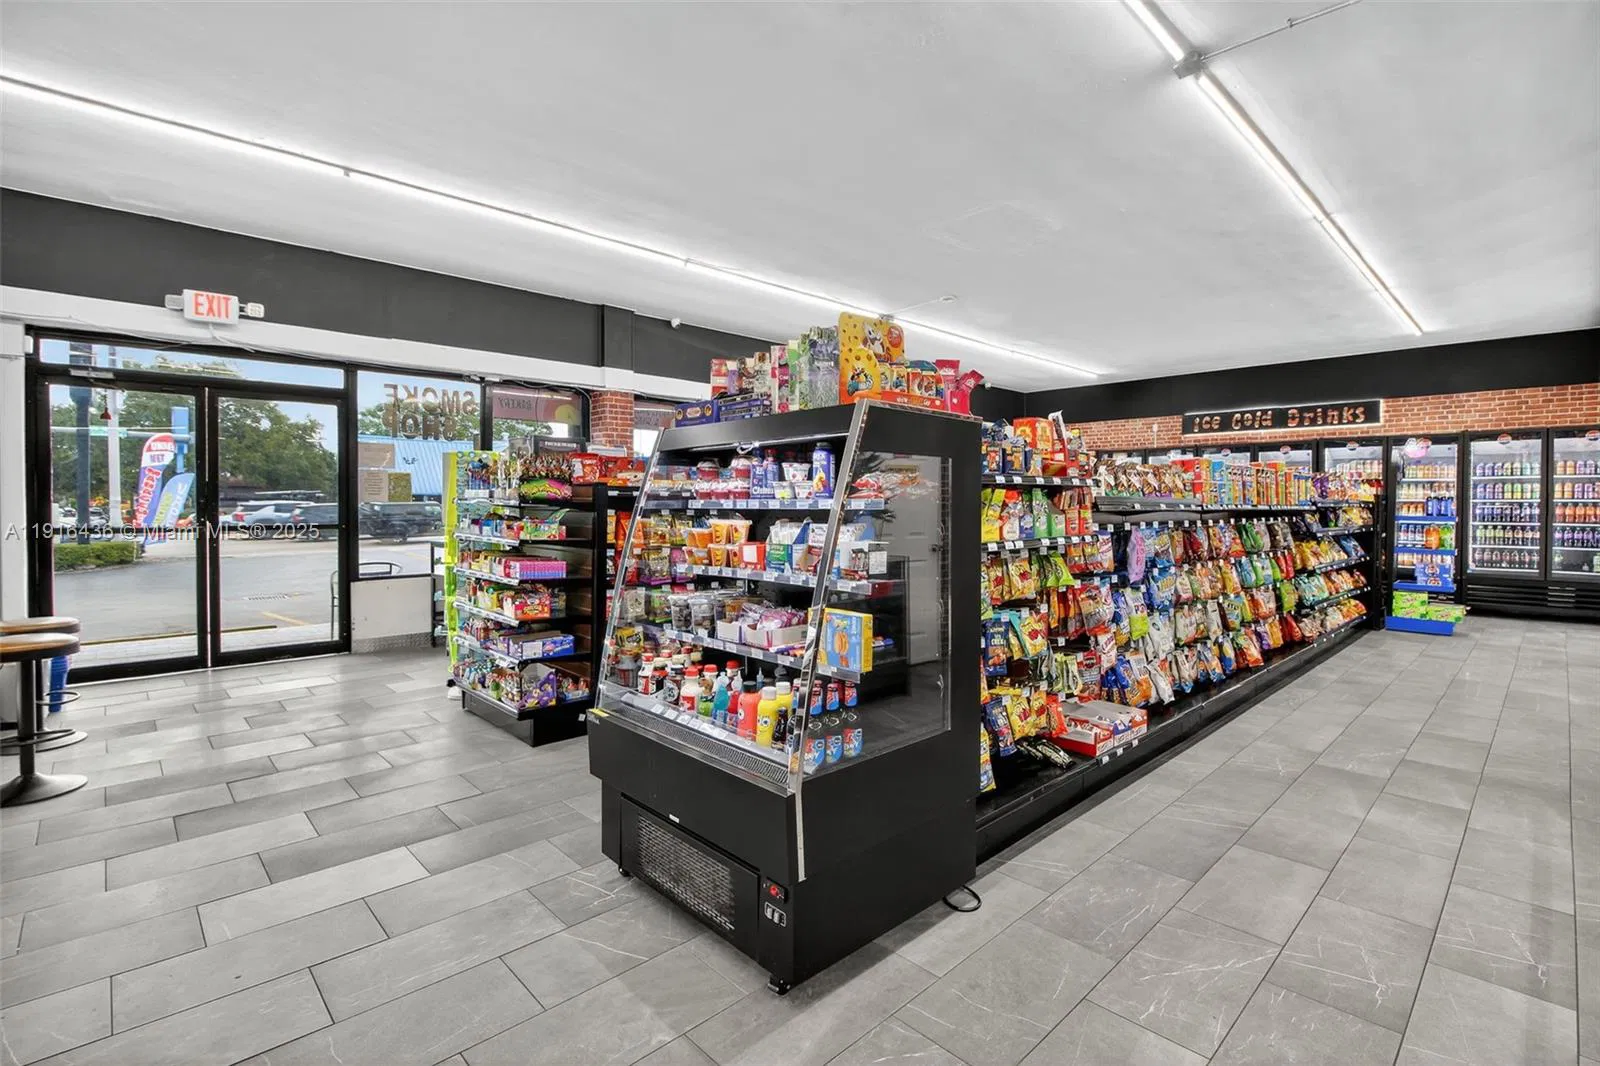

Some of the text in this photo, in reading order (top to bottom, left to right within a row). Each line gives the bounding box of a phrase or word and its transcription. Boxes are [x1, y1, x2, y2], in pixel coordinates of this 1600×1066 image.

[193, 292, 233, 319] EXIT
[1231, 410, 1273, 430] Cold
[1287, 406, 1367, 427] Drinks
